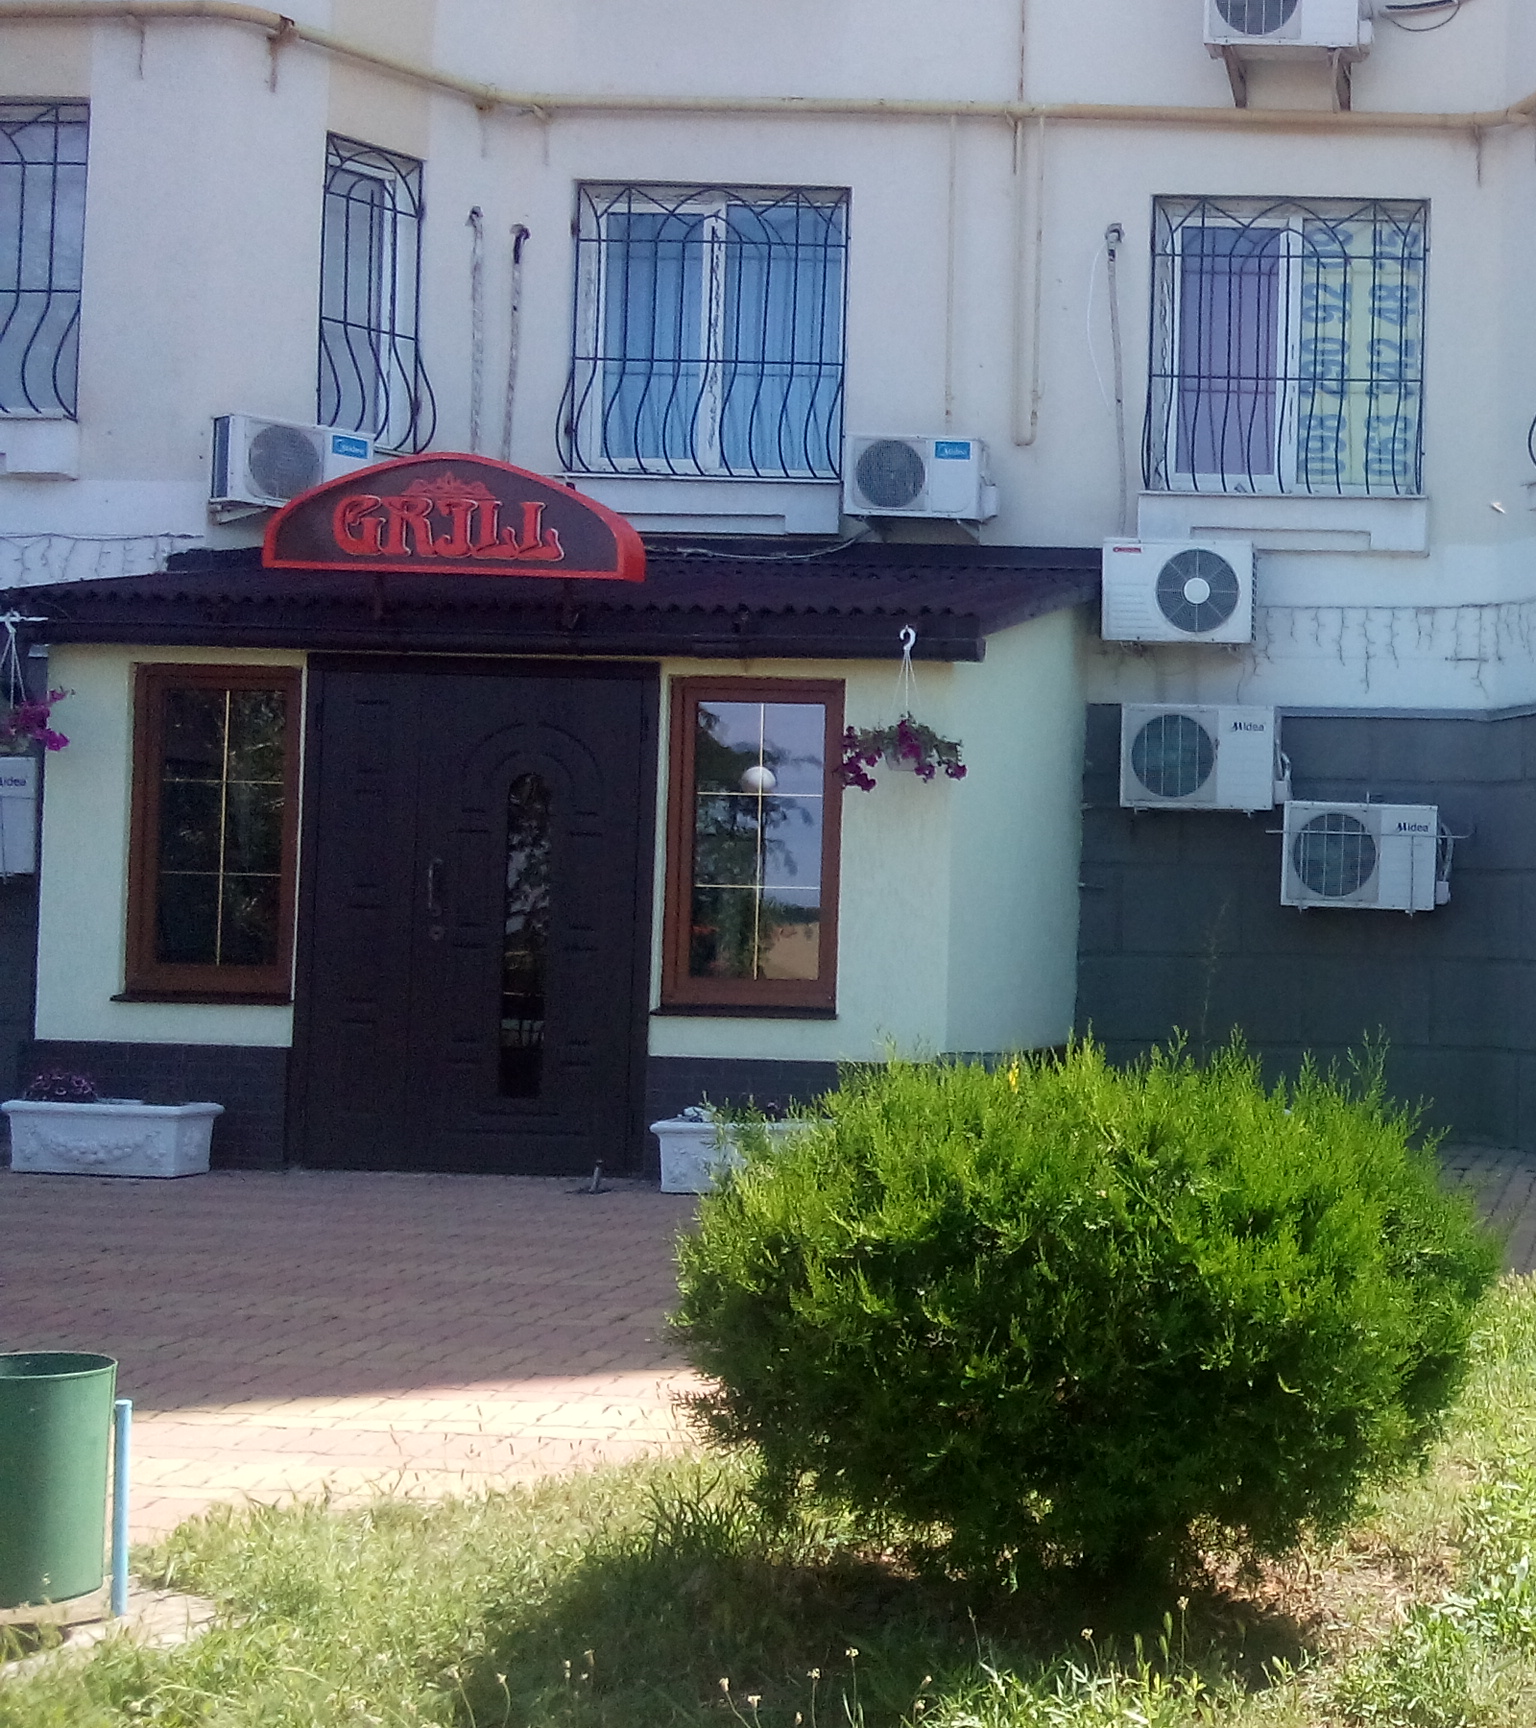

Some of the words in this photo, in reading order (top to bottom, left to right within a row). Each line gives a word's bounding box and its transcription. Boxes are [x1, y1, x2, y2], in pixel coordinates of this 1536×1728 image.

[1301, 283, 1351, 324] 92
[1367, 284, 1418, 325] 48
[1299, 336, 1350, 400] 290
[1297, 413, 1347, 477] 098
[1362, 413, 1412, 478] 063
[333, 494, 564, 561] GRILL
[1230, 721, 1265, 732] Midea
[0, 776, 27, 787] idea
[1395, 821, 1429, 832] Midea
